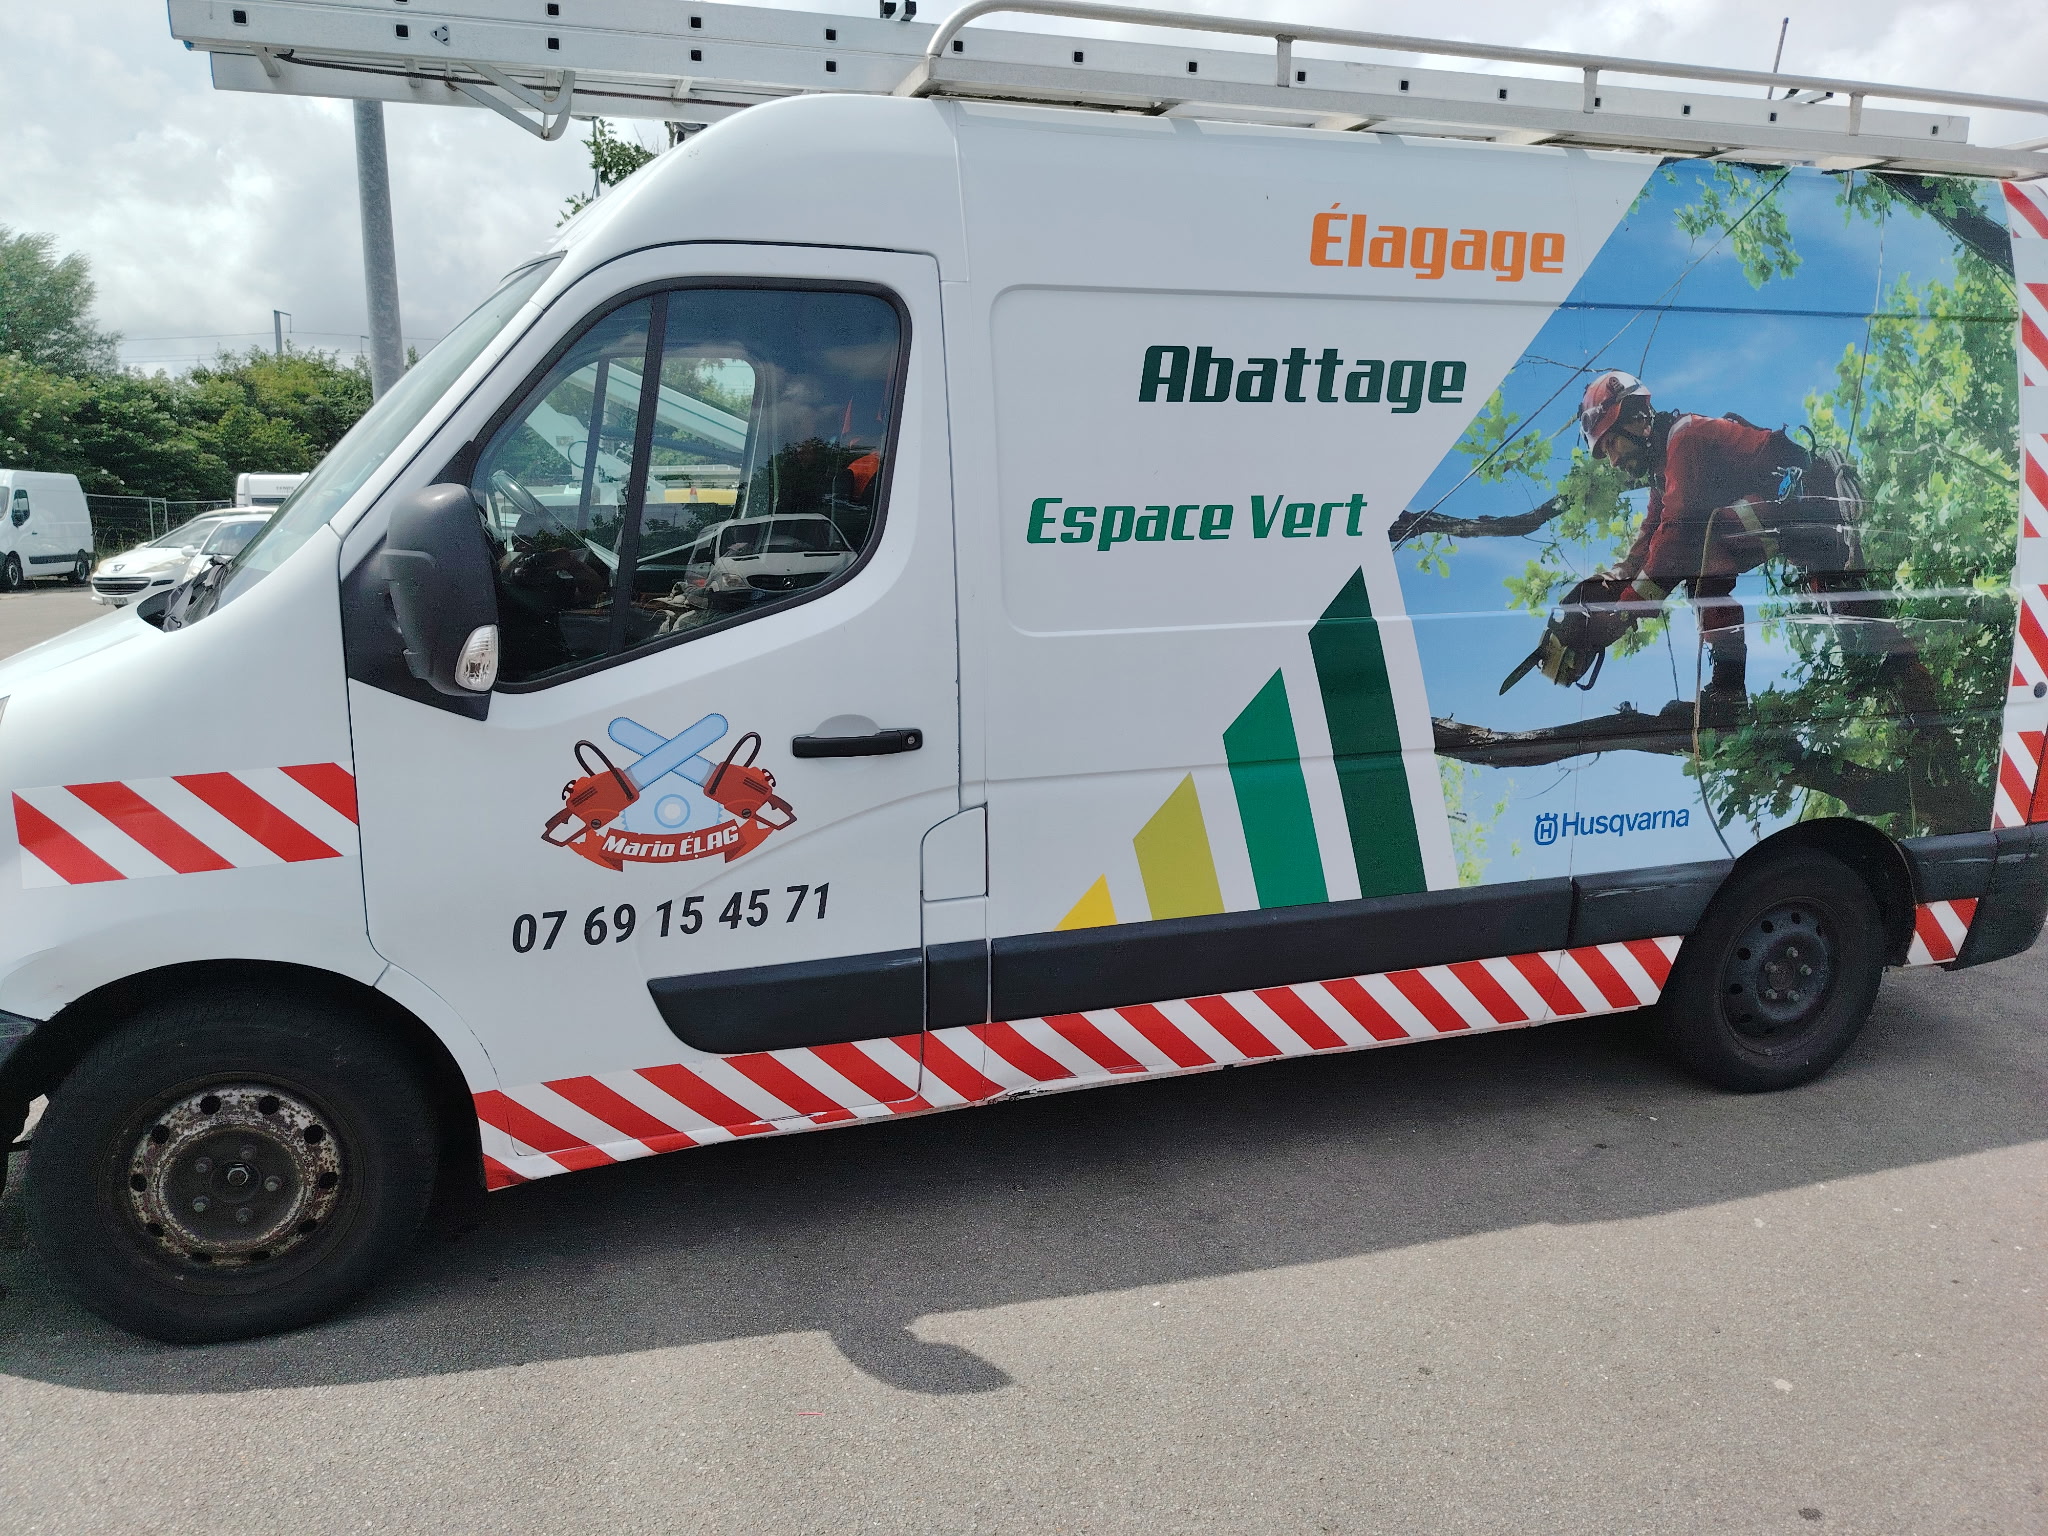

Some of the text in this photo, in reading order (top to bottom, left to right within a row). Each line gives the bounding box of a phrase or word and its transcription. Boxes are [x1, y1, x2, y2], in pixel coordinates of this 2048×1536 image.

[1309, 202, 1566, 283] Élagage
[1138, 345, 1468, 414] Abattage
[1026, 493, 1369, 552] Espace Vert
[602, 825, 739, 857] Mario ÉLAG
[1561, 808, 1691, 837] Husqvarna
[512, 881, 830, 954] 07 69 15 45 71
